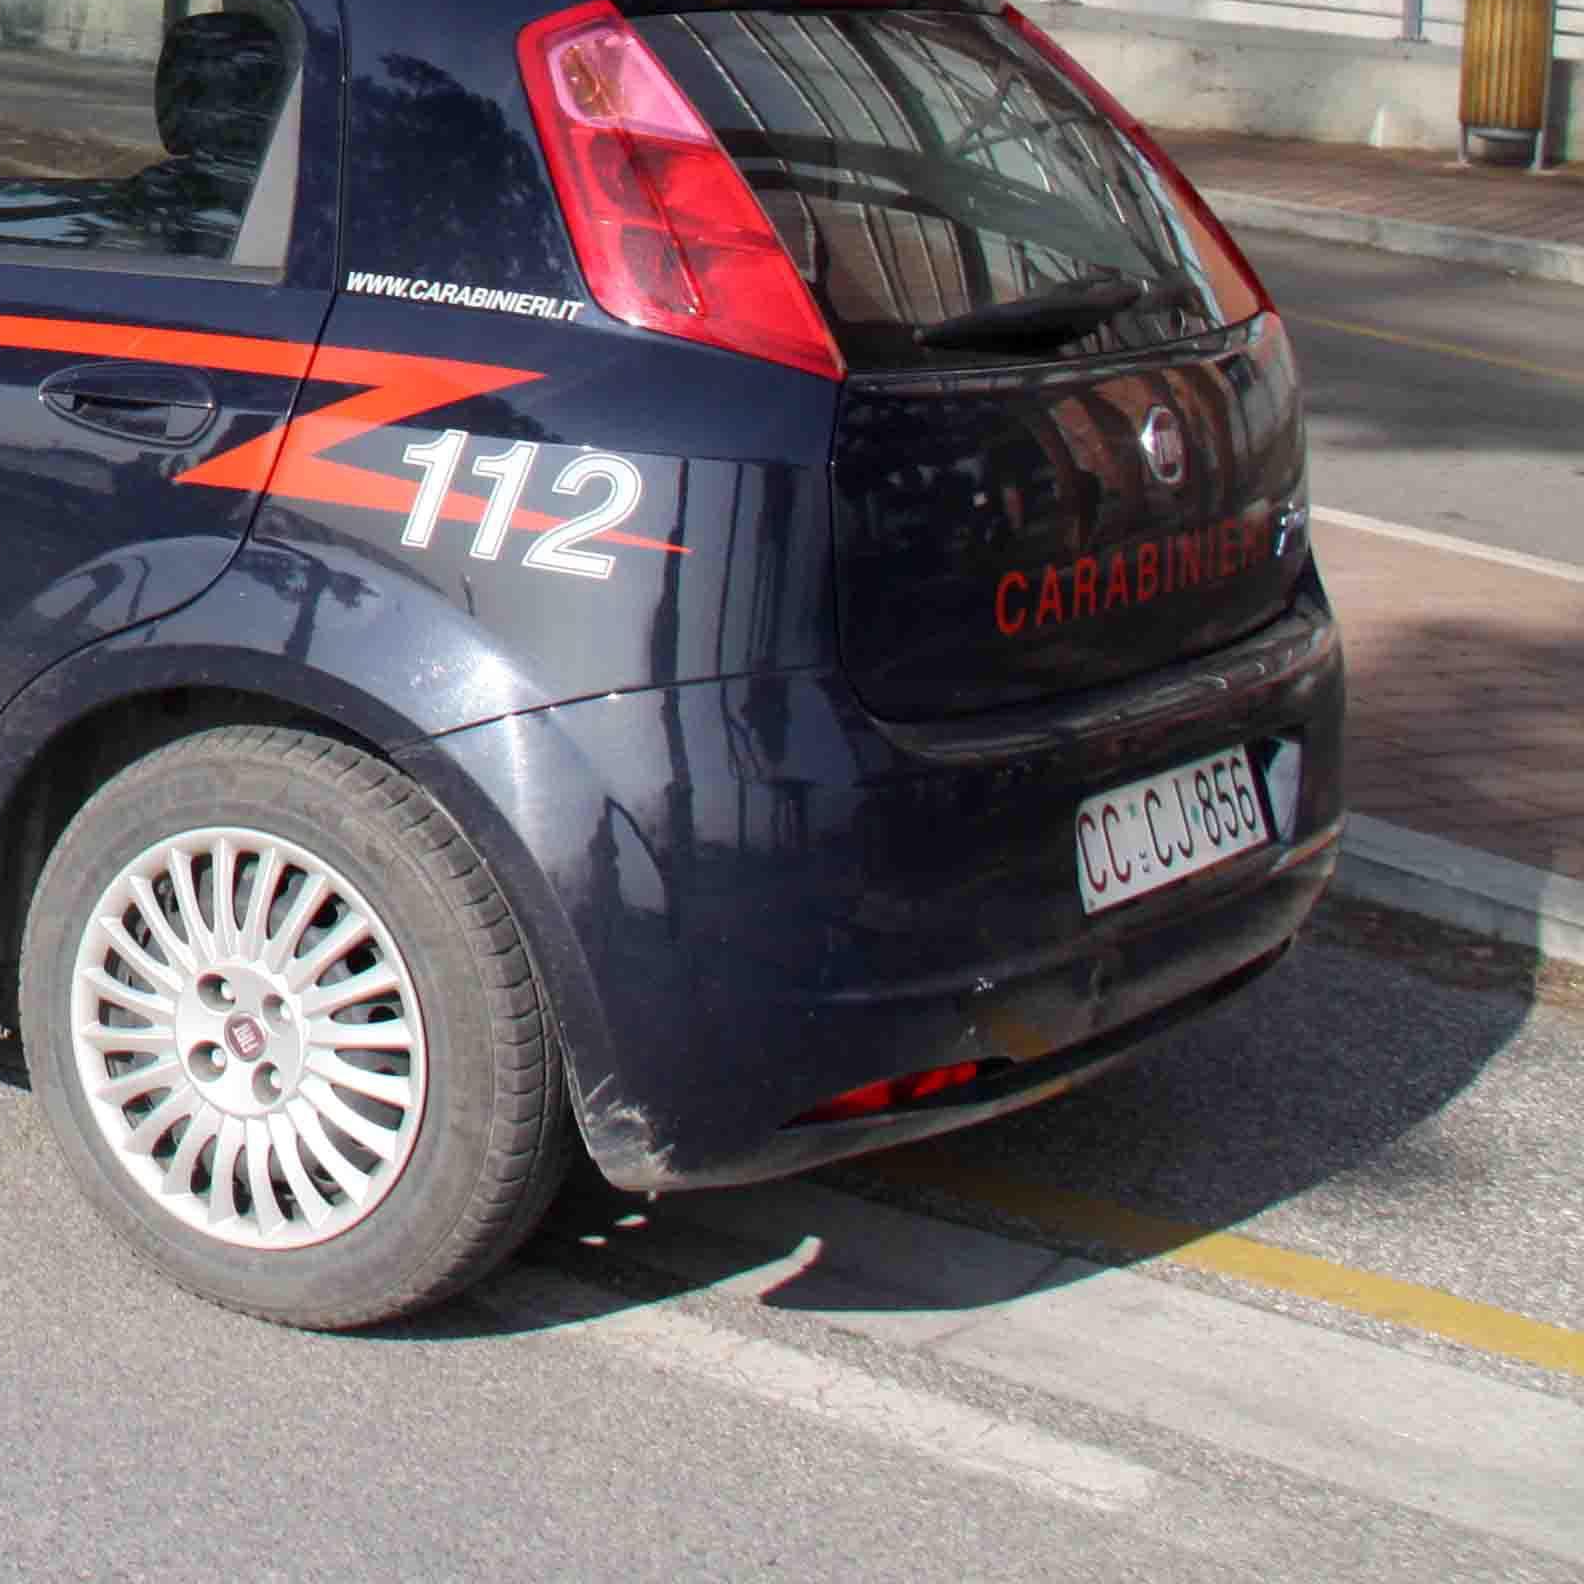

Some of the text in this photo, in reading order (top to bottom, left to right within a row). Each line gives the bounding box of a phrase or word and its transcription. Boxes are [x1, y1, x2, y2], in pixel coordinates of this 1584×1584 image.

[345, 271, 585, 322] WWW.CARABINIERI.IT
[401, 428, 643, 580] 112
[1078, 756, 1257, 894] CC CJ 856
